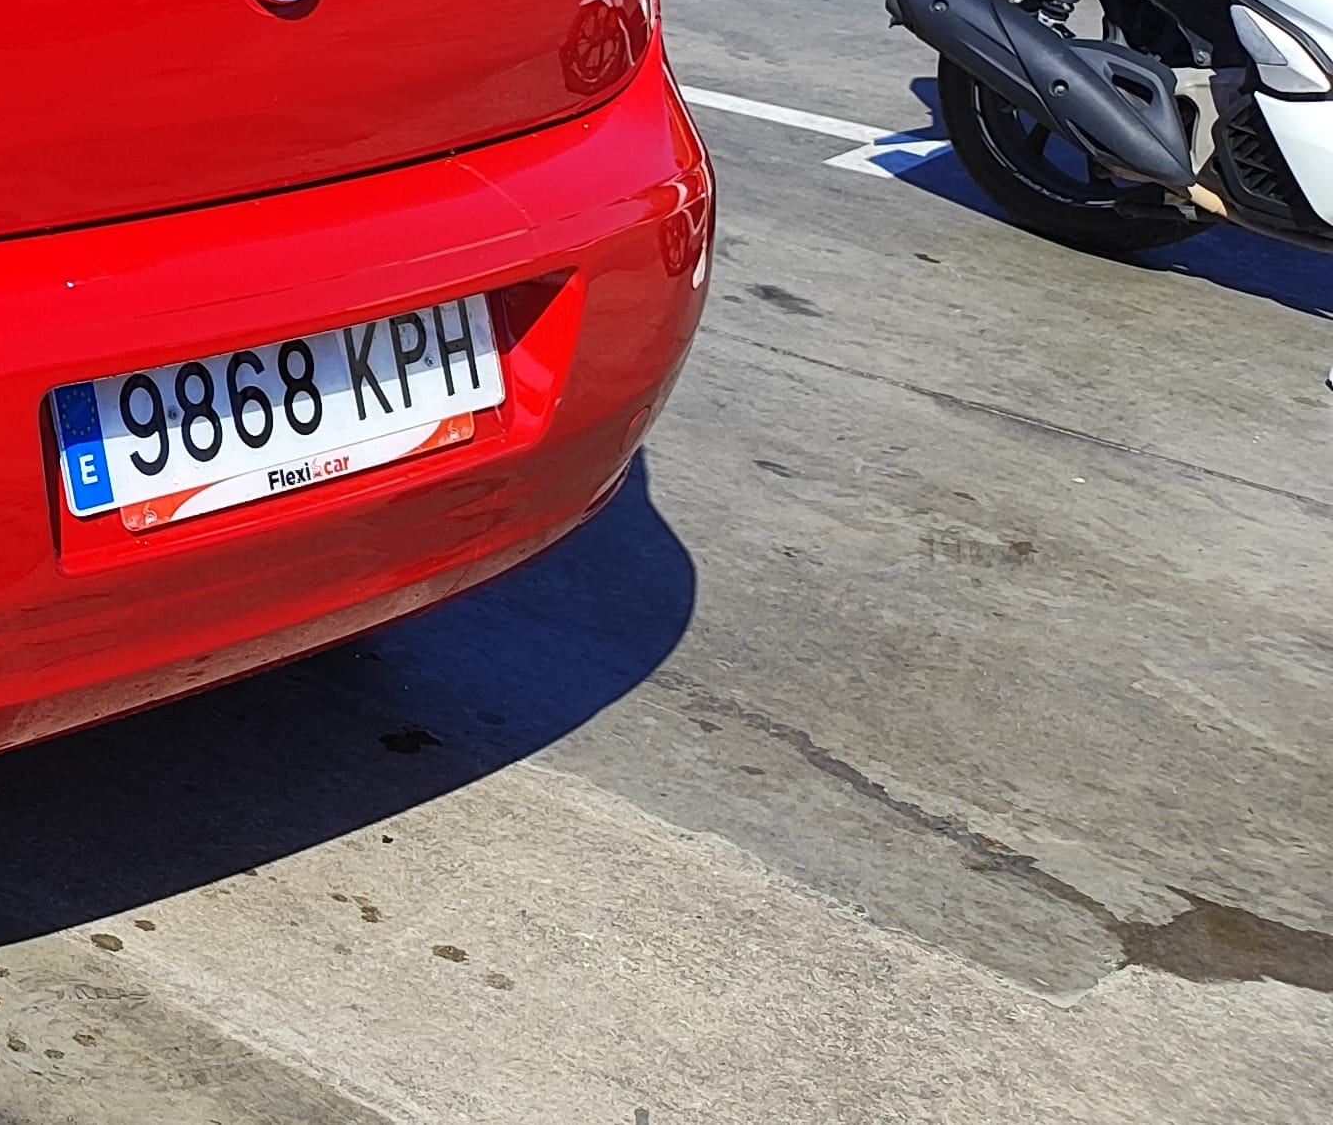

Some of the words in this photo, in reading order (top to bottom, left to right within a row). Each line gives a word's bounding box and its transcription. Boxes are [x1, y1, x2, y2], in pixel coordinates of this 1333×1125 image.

[119, 338, 324, 477] 9868
[343, 296, 481, 421] KPH
[79, 454, 99, 486] E
